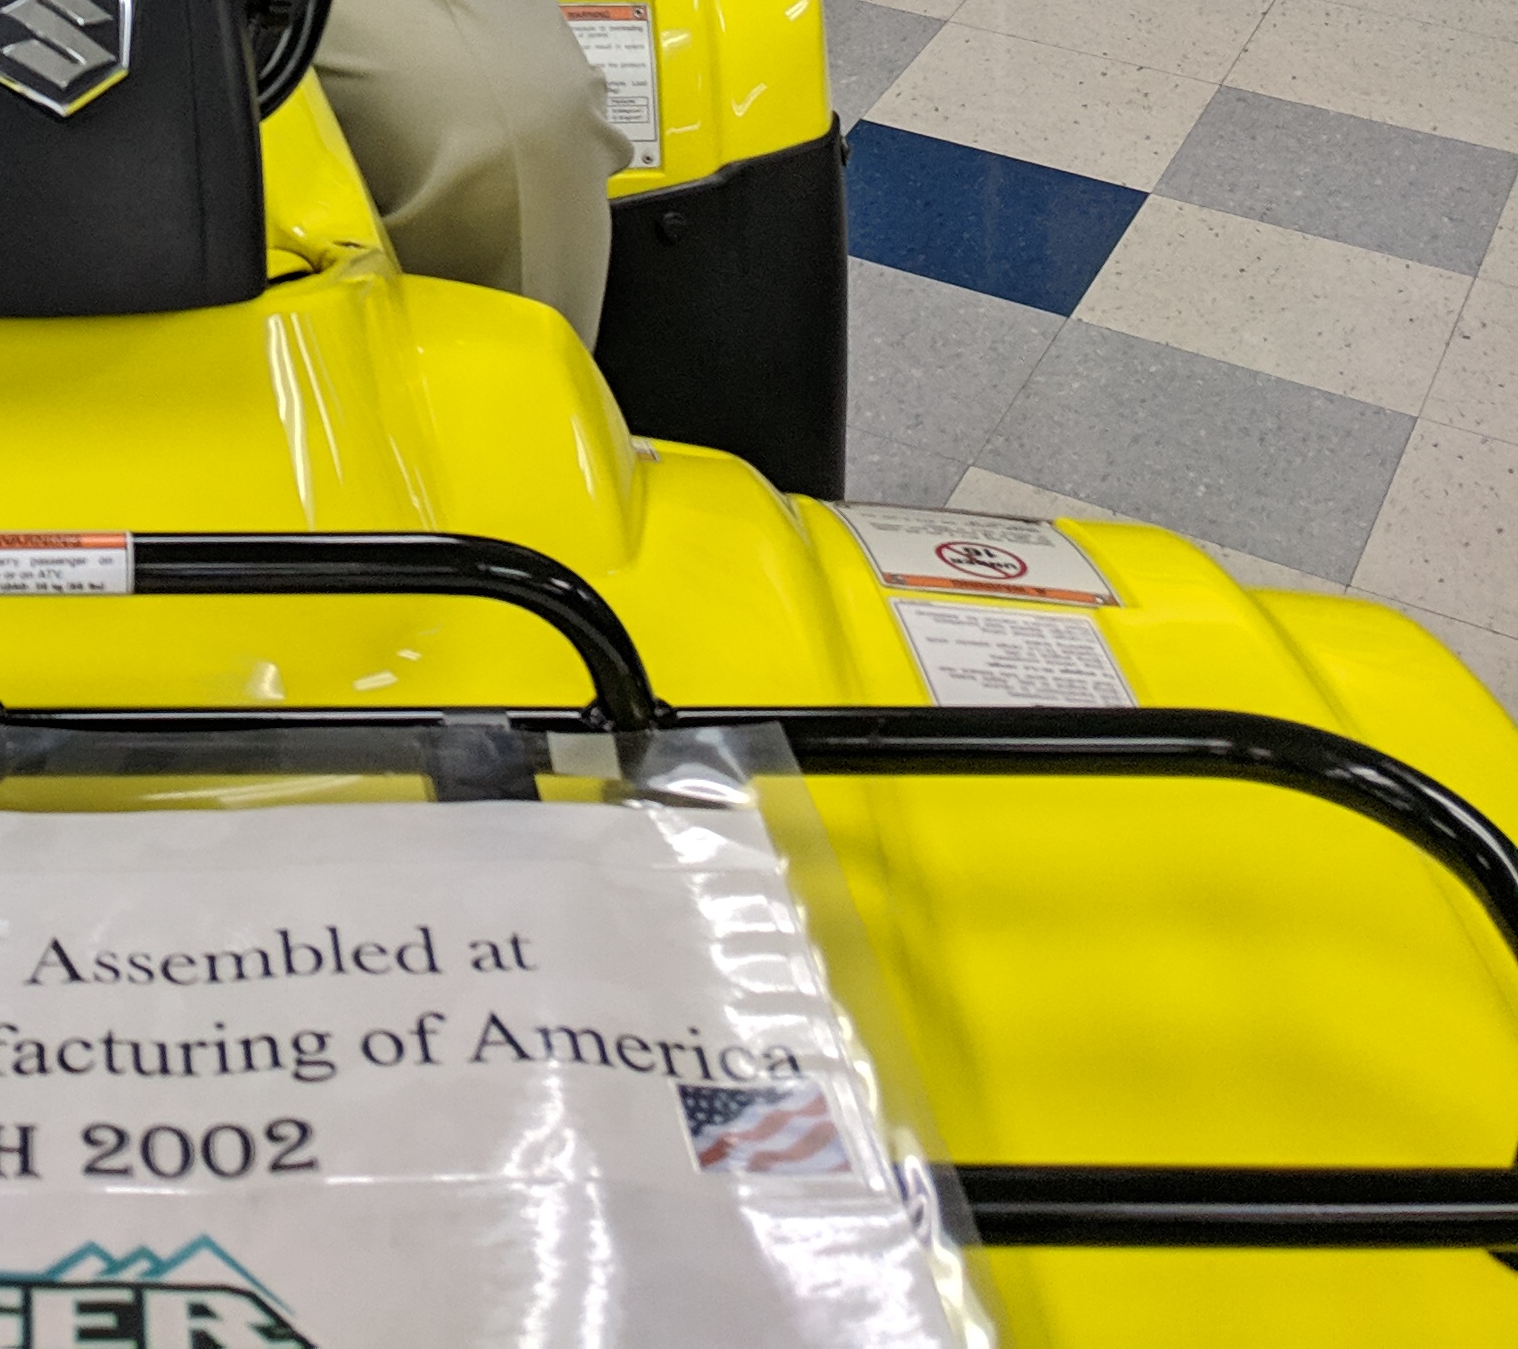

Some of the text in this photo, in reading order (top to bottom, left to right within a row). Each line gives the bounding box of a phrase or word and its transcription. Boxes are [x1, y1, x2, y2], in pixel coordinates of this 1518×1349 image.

[25, 926, 443, 984] Assembled
[470, 932, 539, 974] at
[361, 1012, 448, 1068] of
[470, 1012, 804, 1081] America
[81, 1116, 320, 1180] 2002
